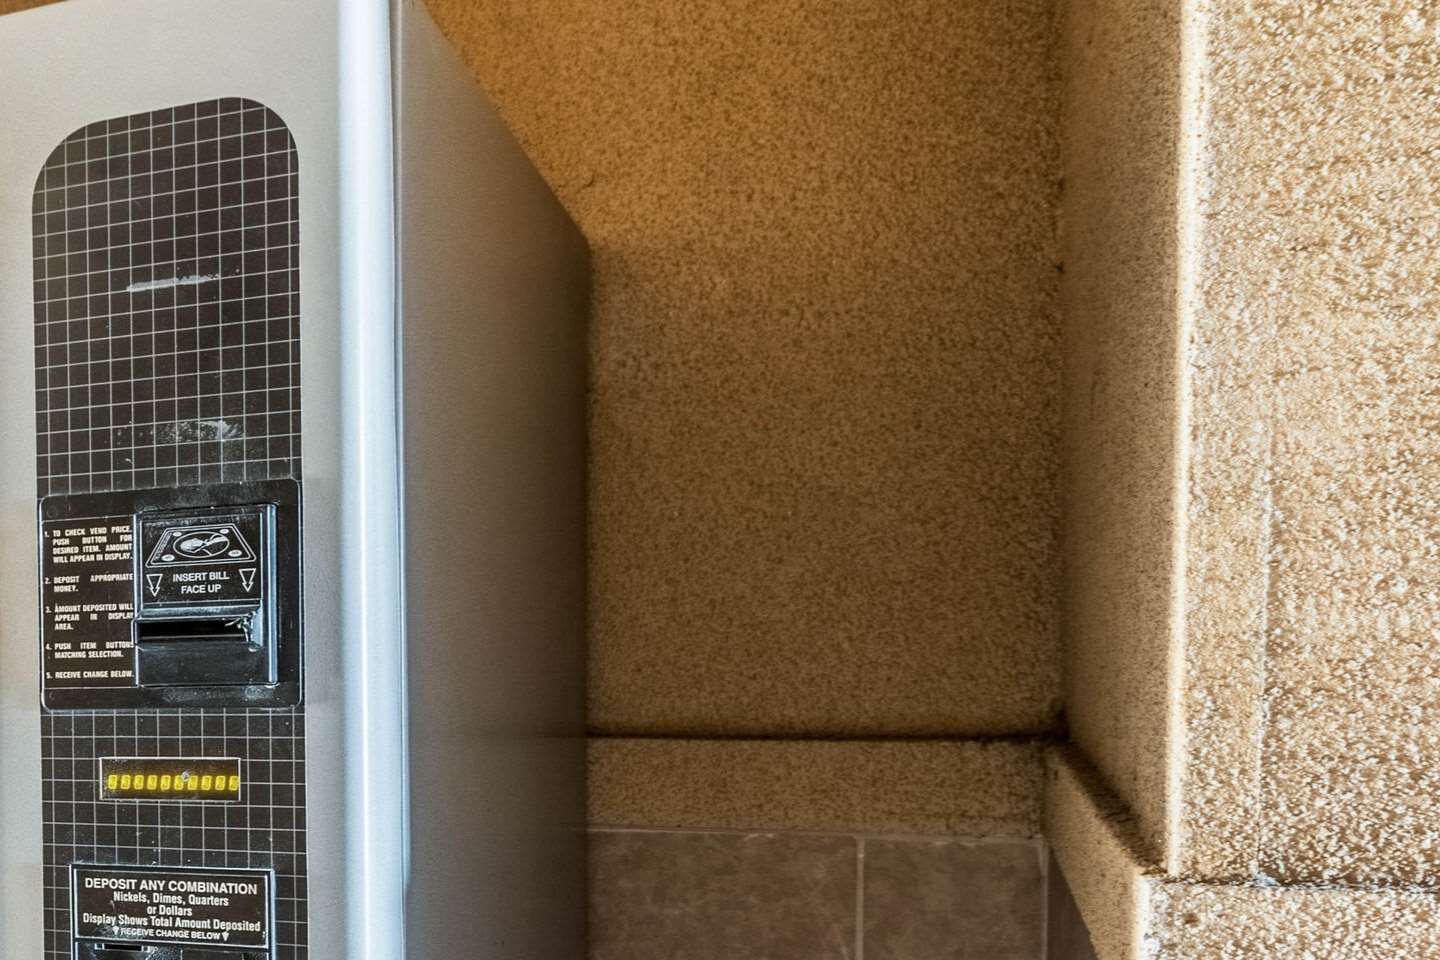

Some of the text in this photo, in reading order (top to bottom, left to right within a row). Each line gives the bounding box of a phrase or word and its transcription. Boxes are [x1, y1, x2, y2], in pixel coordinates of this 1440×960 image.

[65, 528, 86, 536] CHECK
[90, 527, 107, 535] VEND
[53, 534, 133, 546] PUSH BUTTON FOR
[53, 546, 79, 554] DESIRED
[105, 543, 133, 552] AMOUNT
[70, 554, 95, 562] APPEAR
[104, 552, 134, 560] DISPLAY.
[53, 576, 80, 584] DEPOSIT
[90, 573, 133, 582] APPROPRIATE
[172, 570, 230, 582] INSERT BILL
[54, 585, 79, 593] MONEY.
[181, 584, 221, 594] FACE UP
[54, 604, 81, 613] AMOUNT
[82, 603, 117, 612] DEPOSITED
[54, 613, 80, 621] APPEAR
[54, 623, 74, 631] AREA.
[54, 642, 72, 650] PUSH
[54, 650, 124, 659] MATCHING SELECTION.
[55, 671, 81, 679] RECEIVE
[83, 670, 108, 678] CHANGE
[110, 670, 135, 678] BELOW.
[85, 878, 258, 895] DEPOSIT ANY COMBINATION
[113, 891, 229, 906] Nickels, Dimes, Quarters
[147, 905, 192, 917] or Dollars
[83, 912, 261, 932] Display Shows Total Amount Deposited
[121, 928, 220, 940] RECEIVE CHANGE BELOW
